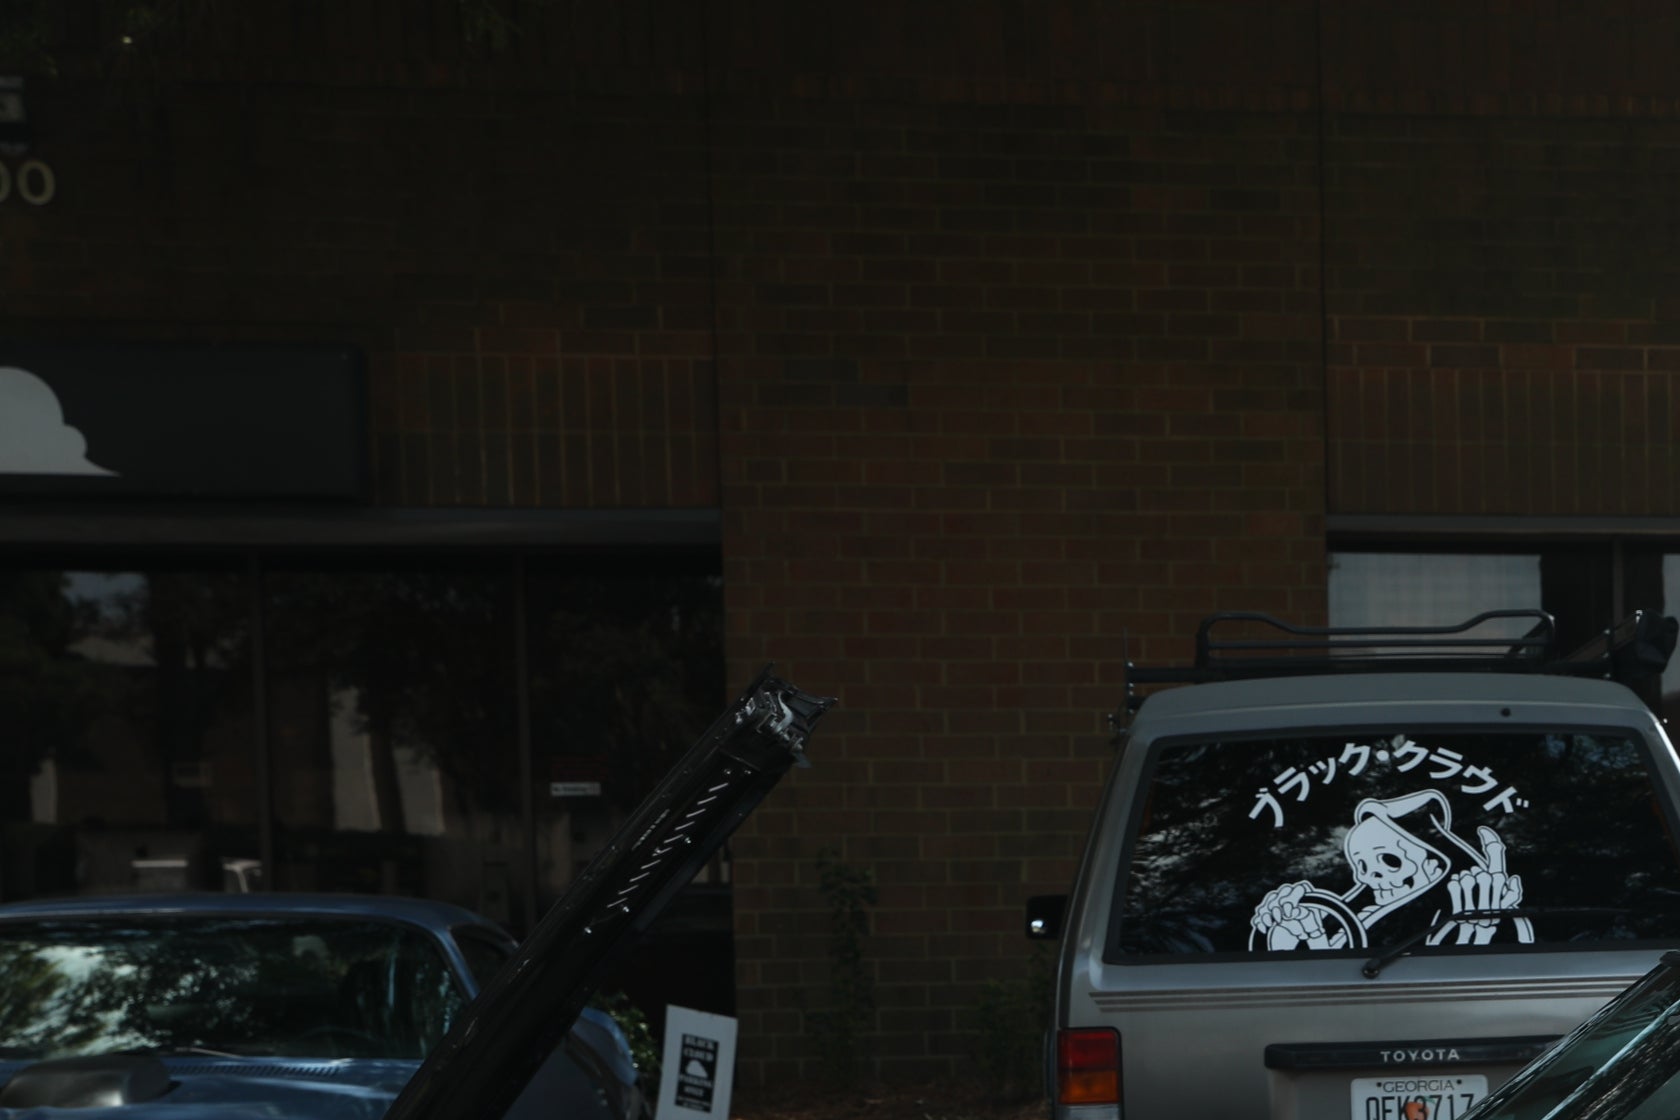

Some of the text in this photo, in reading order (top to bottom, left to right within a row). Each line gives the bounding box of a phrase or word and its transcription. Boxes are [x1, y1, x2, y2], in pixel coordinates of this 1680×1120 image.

[1247, 740, 1530, 828] ブラック・クラウド
[1380, 1048, 1461, 1062] TOYOTA
[1383, 1079, 1455, 1093] GEORGIA
